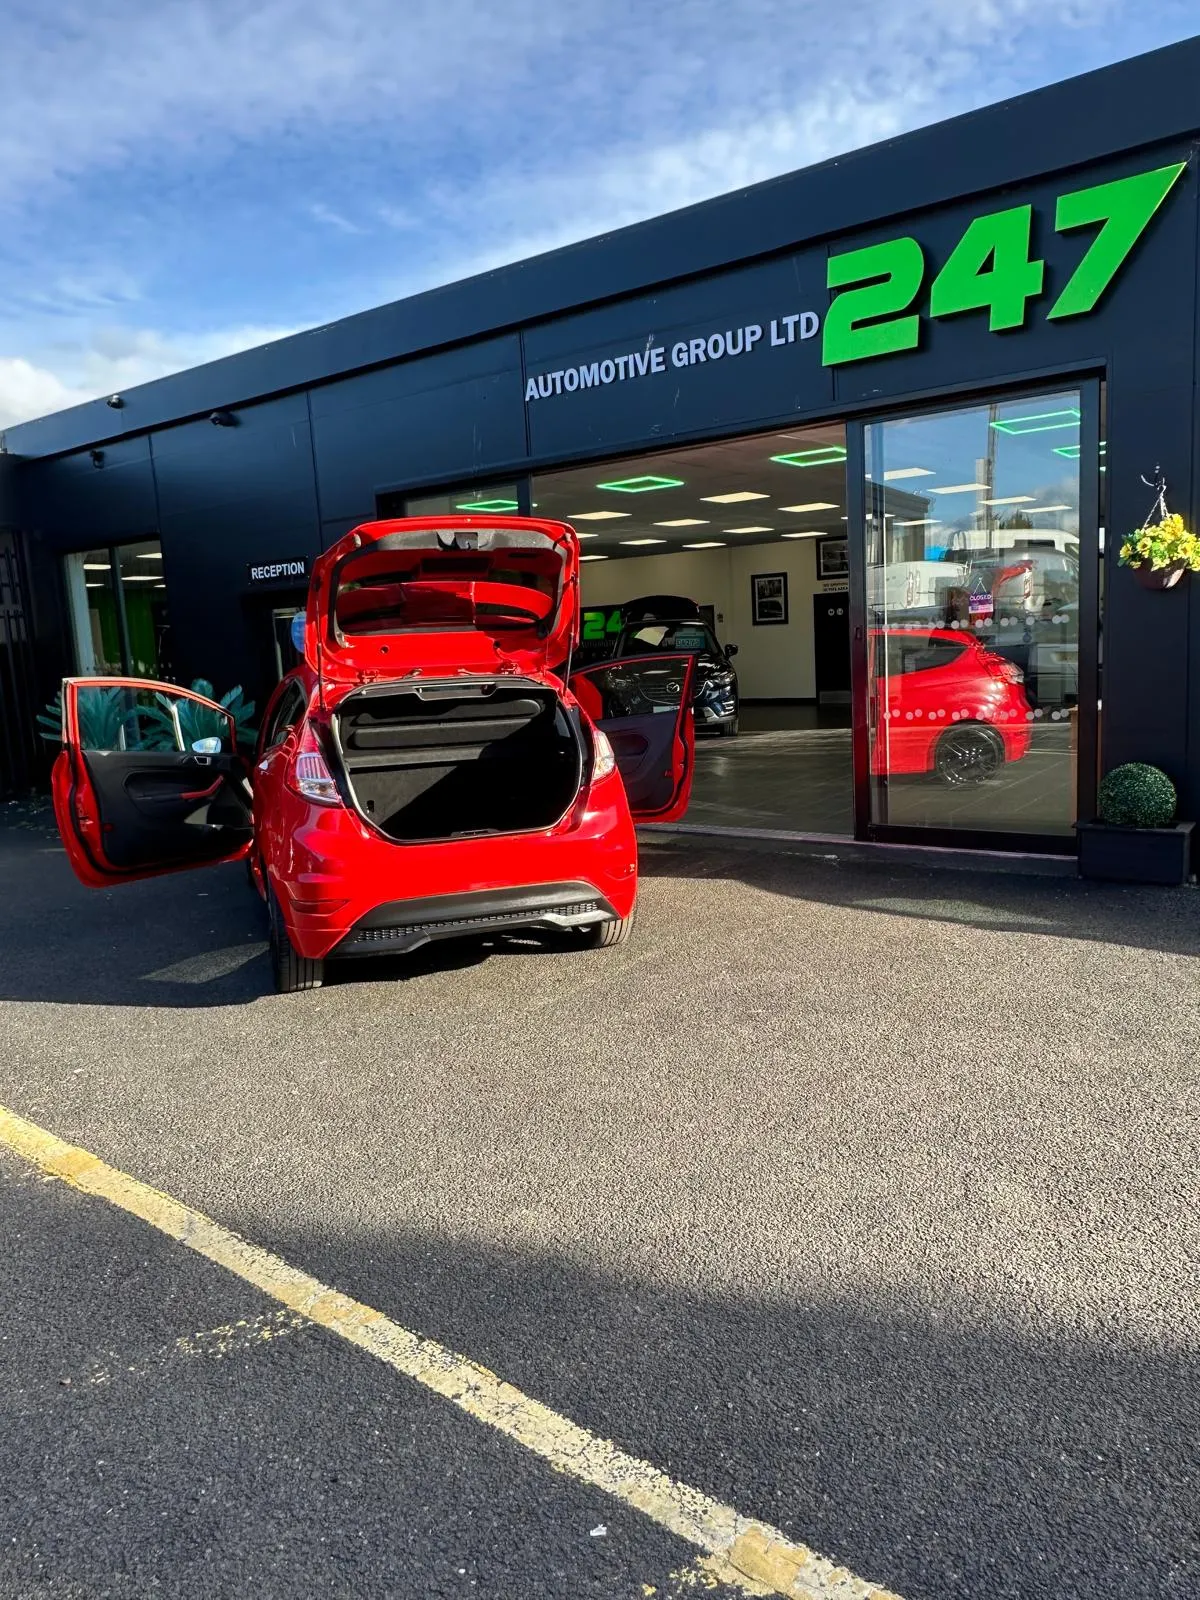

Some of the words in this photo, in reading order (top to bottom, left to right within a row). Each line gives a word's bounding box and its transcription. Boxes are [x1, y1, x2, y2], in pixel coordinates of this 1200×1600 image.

[822, 161, 1187, 366] 247
[524, 346, 666, 402] AUTOMOTIVE
[671, 324, 763, 368] GROUP
[770, 311, 820, 347] LTD
[251, 561, 305, 580] RECEPTION
